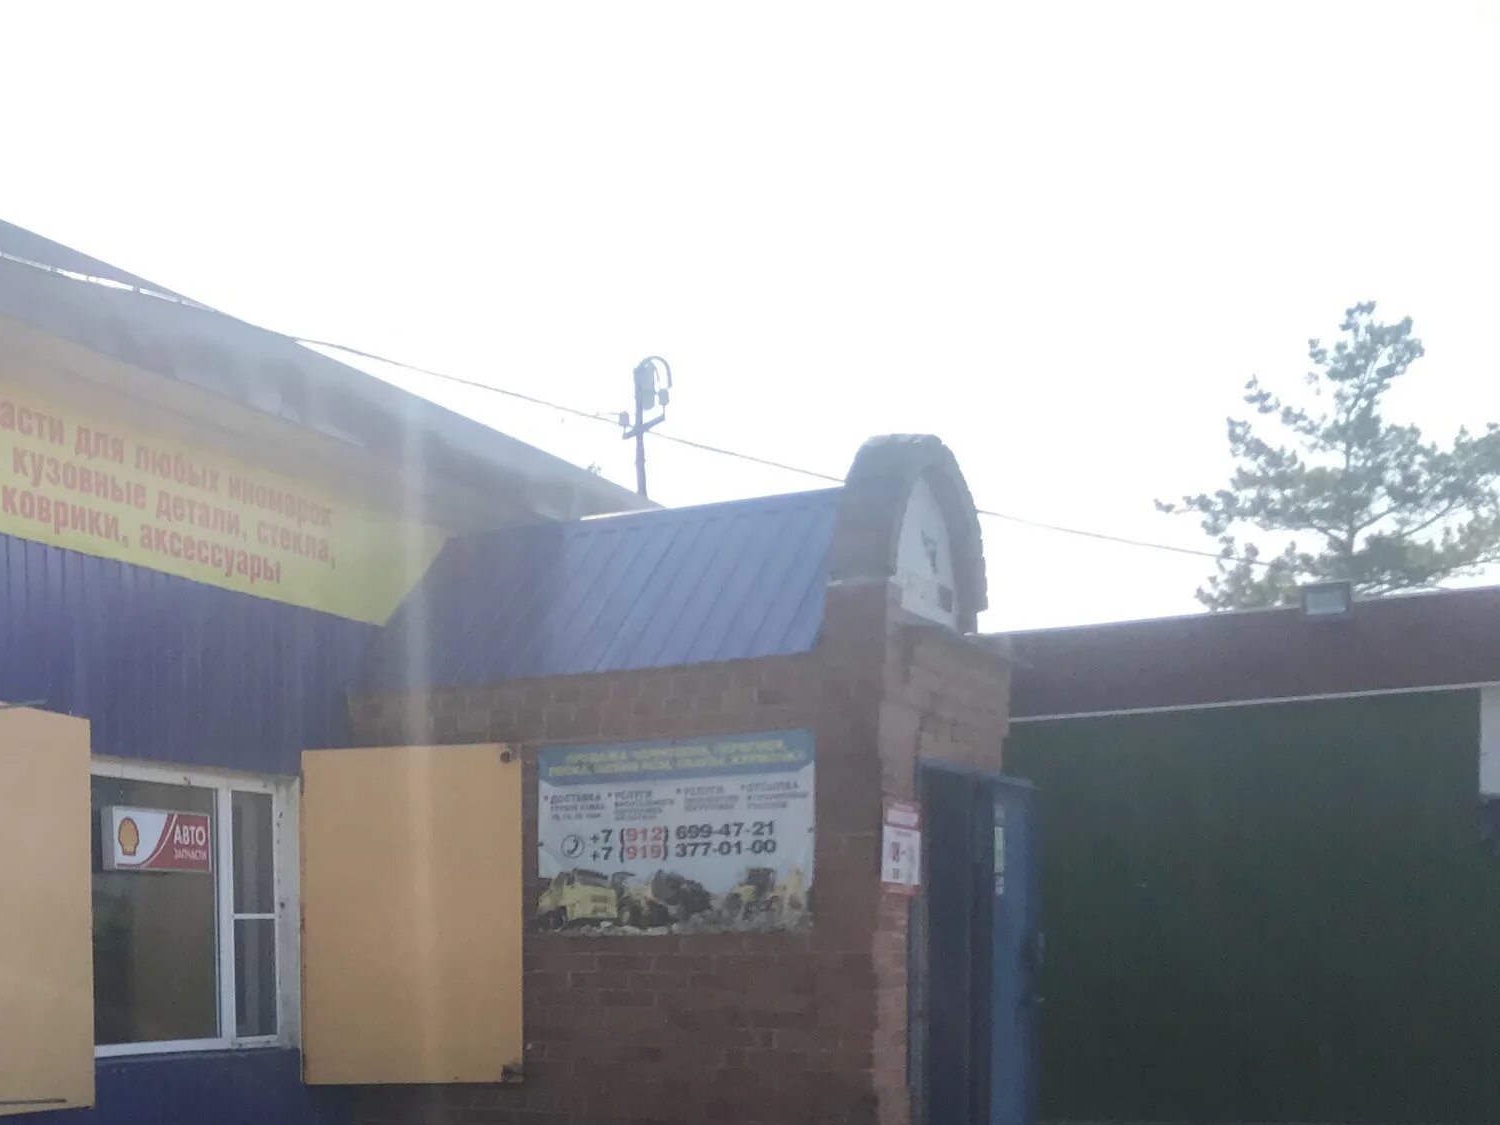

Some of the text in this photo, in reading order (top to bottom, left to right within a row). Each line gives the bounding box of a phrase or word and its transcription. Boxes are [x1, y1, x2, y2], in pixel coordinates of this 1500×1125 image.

[12, 445, 147, 509] кузовные
[257, 523, 337, 570] стекла,
[75, 426, 125, 464] для
[134, 445, 220, 494] любых
[228, 476, 333, 528] иномарок
[1, 485, 282, 584] коврики, аксессуары
[173, 824, 206, 847] АВТО
